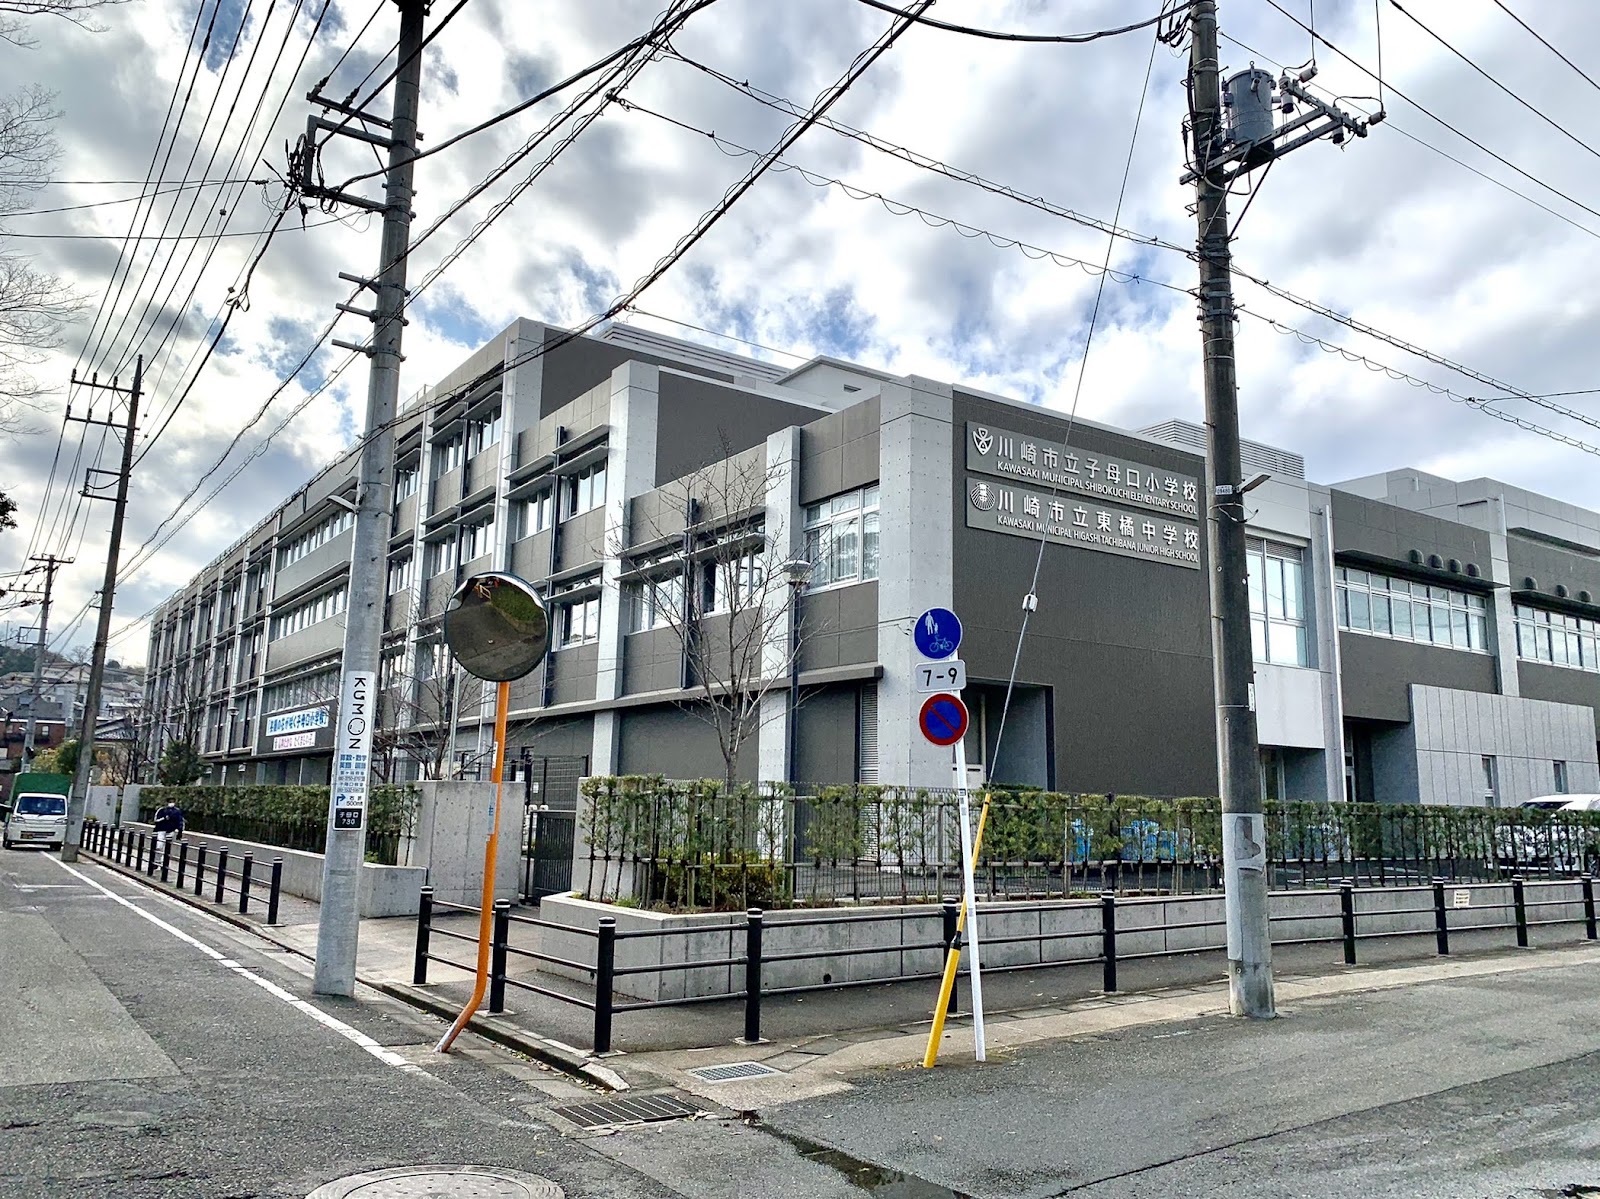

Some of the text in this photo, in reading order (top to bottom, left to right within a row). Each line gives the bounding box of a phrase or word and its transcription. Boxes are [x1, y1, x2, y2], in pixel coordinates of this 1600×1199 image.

[997, 461, 1198, 515] KAWASAKI MUNICIPAL SHIBOKUCHI ELEMENTARY SCHOOL
[998, 435, 1197, 502] 川崎市立子母口小学校
[997, 514, 1034, 531] KAWASAKI
[1036, 522, 1072, 538] MUNICIPAL
[1137, 544, 1159, 555] JUNIOR
[1160, 547, 1175, 558] HIGH
[1175, 551, 1199, 563] SCHOOL
[998, 489, 1198, 550] 川崎市立東橘中学校
[923, 667, 958, 686] 7-9
[347, 677, 367, 749] KUMON
